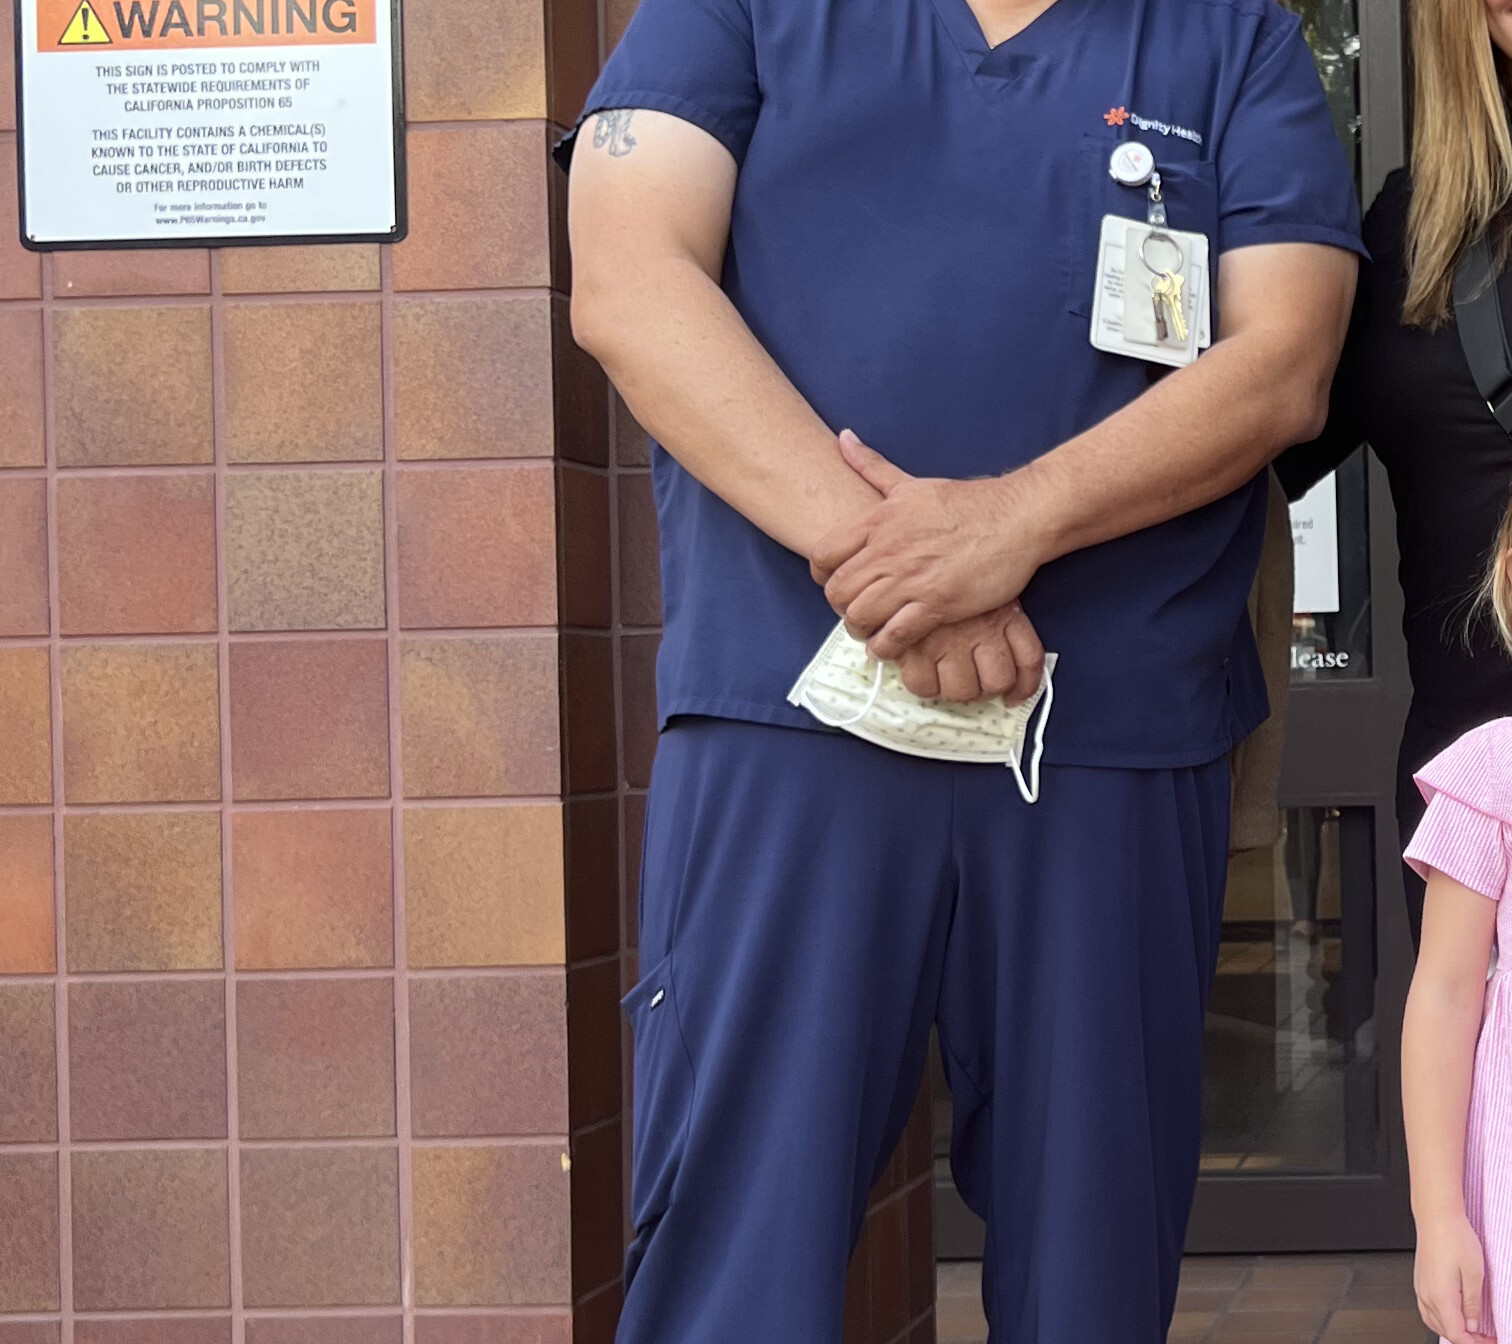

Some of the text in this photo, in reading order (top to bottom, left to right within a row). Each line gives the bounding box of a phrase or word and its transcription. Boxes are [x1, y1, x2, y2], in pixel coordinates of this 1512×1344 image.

[95, 59, 320, 78] THIS SIGN IS POSTED TO COMPLY WITH
[106, 77, 311, 95] THE STATEWIDE REQUIREMENTS OF
[124, 96, 293, 112] CALIFORNIA PROPOSITION 65
[91, 123, 326, 141] THIS FACILITY CONTAINS A CHEMICAL(S)
[1131, 112, 1171, 136] Dignity
[91, 140, 328, 158] KNOWN TO THE STATE OF CALIFORNIA TO
[92, 158, 328, 177] CAUSE CANCER, AND/OR BIRTH DEFECTS
[116, 176, 304, 194] OR OTHER REPRODUCTIVE HARM
[194, 201, 244, 212] information
[1290, 645, 1349, 668] lease
